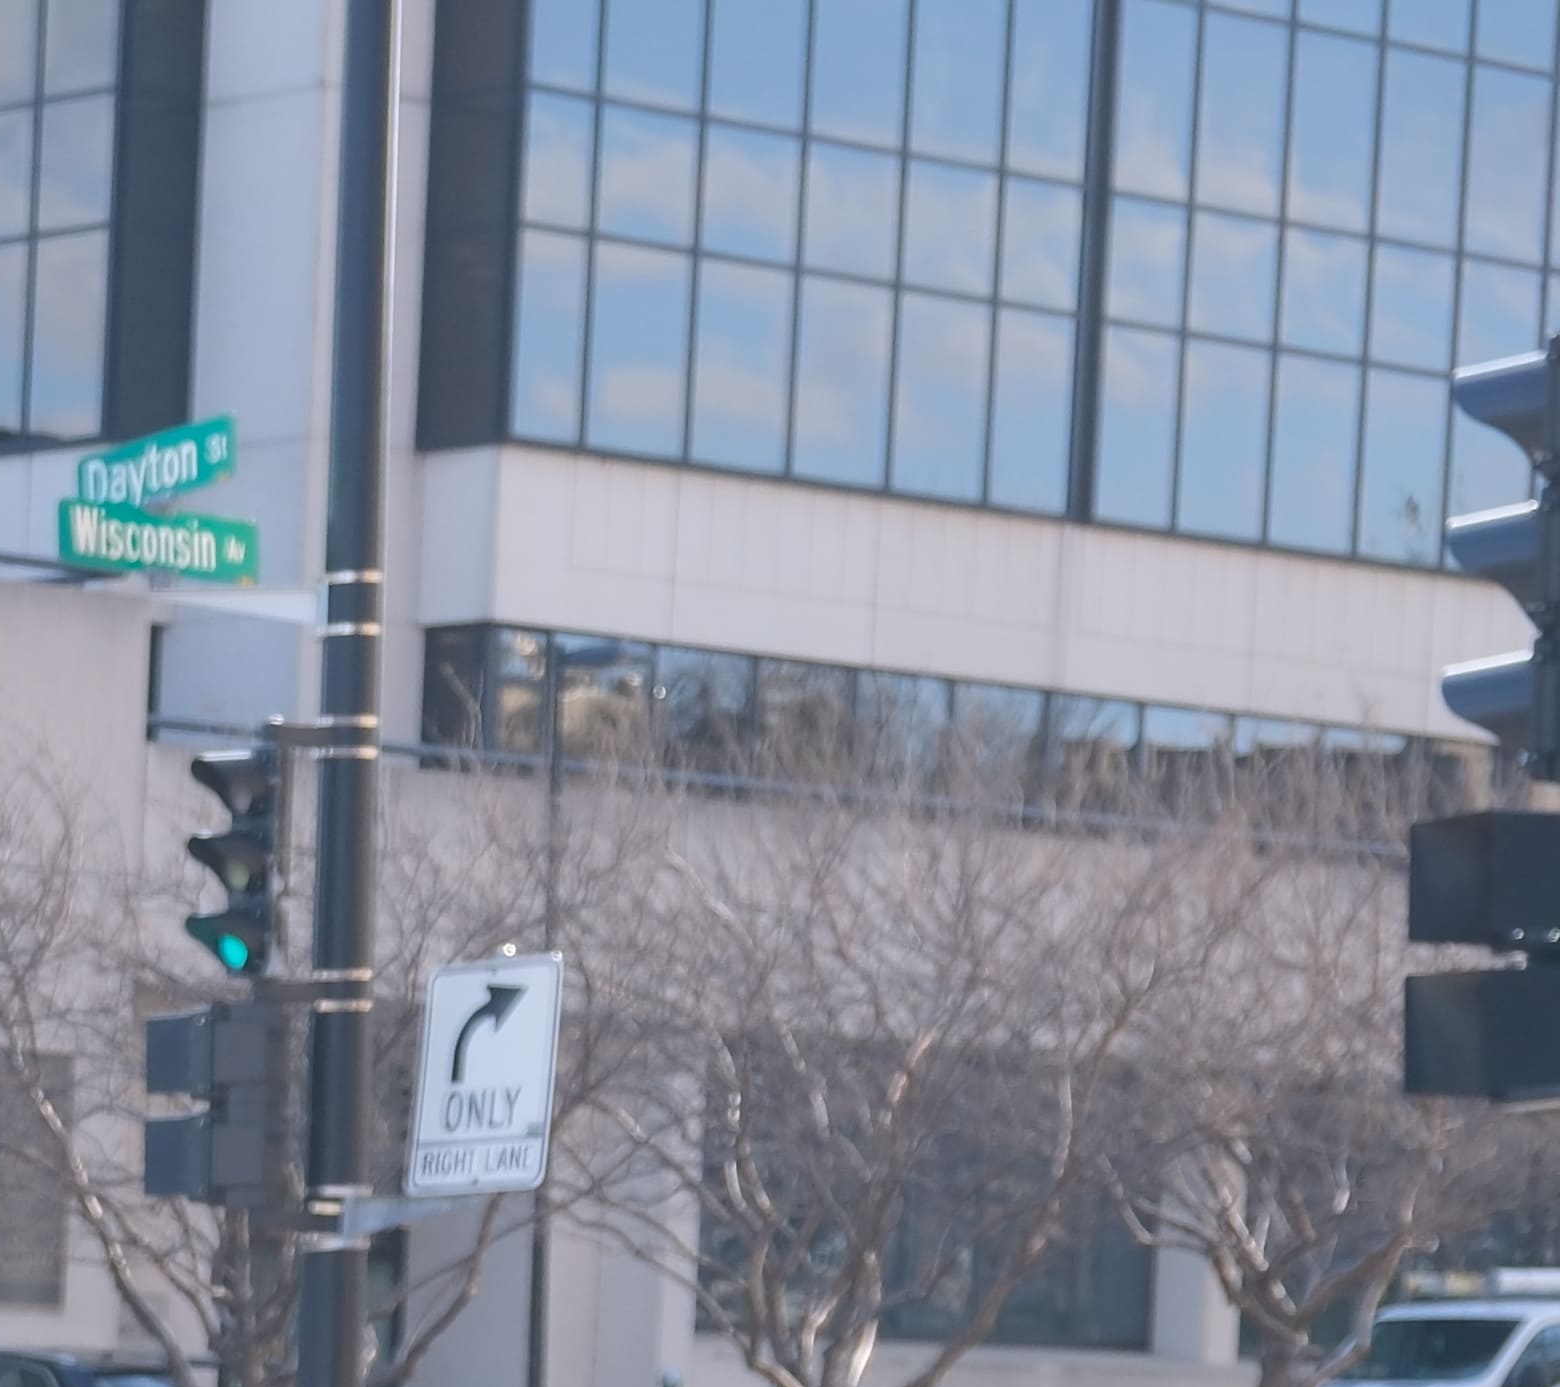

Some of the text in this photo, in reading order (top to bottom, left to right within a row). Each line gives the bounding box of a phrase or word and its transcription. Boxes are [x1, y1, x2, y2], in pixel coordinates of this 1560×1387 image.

[86, 433, 228, 508] Dayton St
[71, 504, 216, 572] Wisconsin
[445, 1086, 522, 1133] ONLY
[422, 1145, 531, 1177] RIGHT LANE
